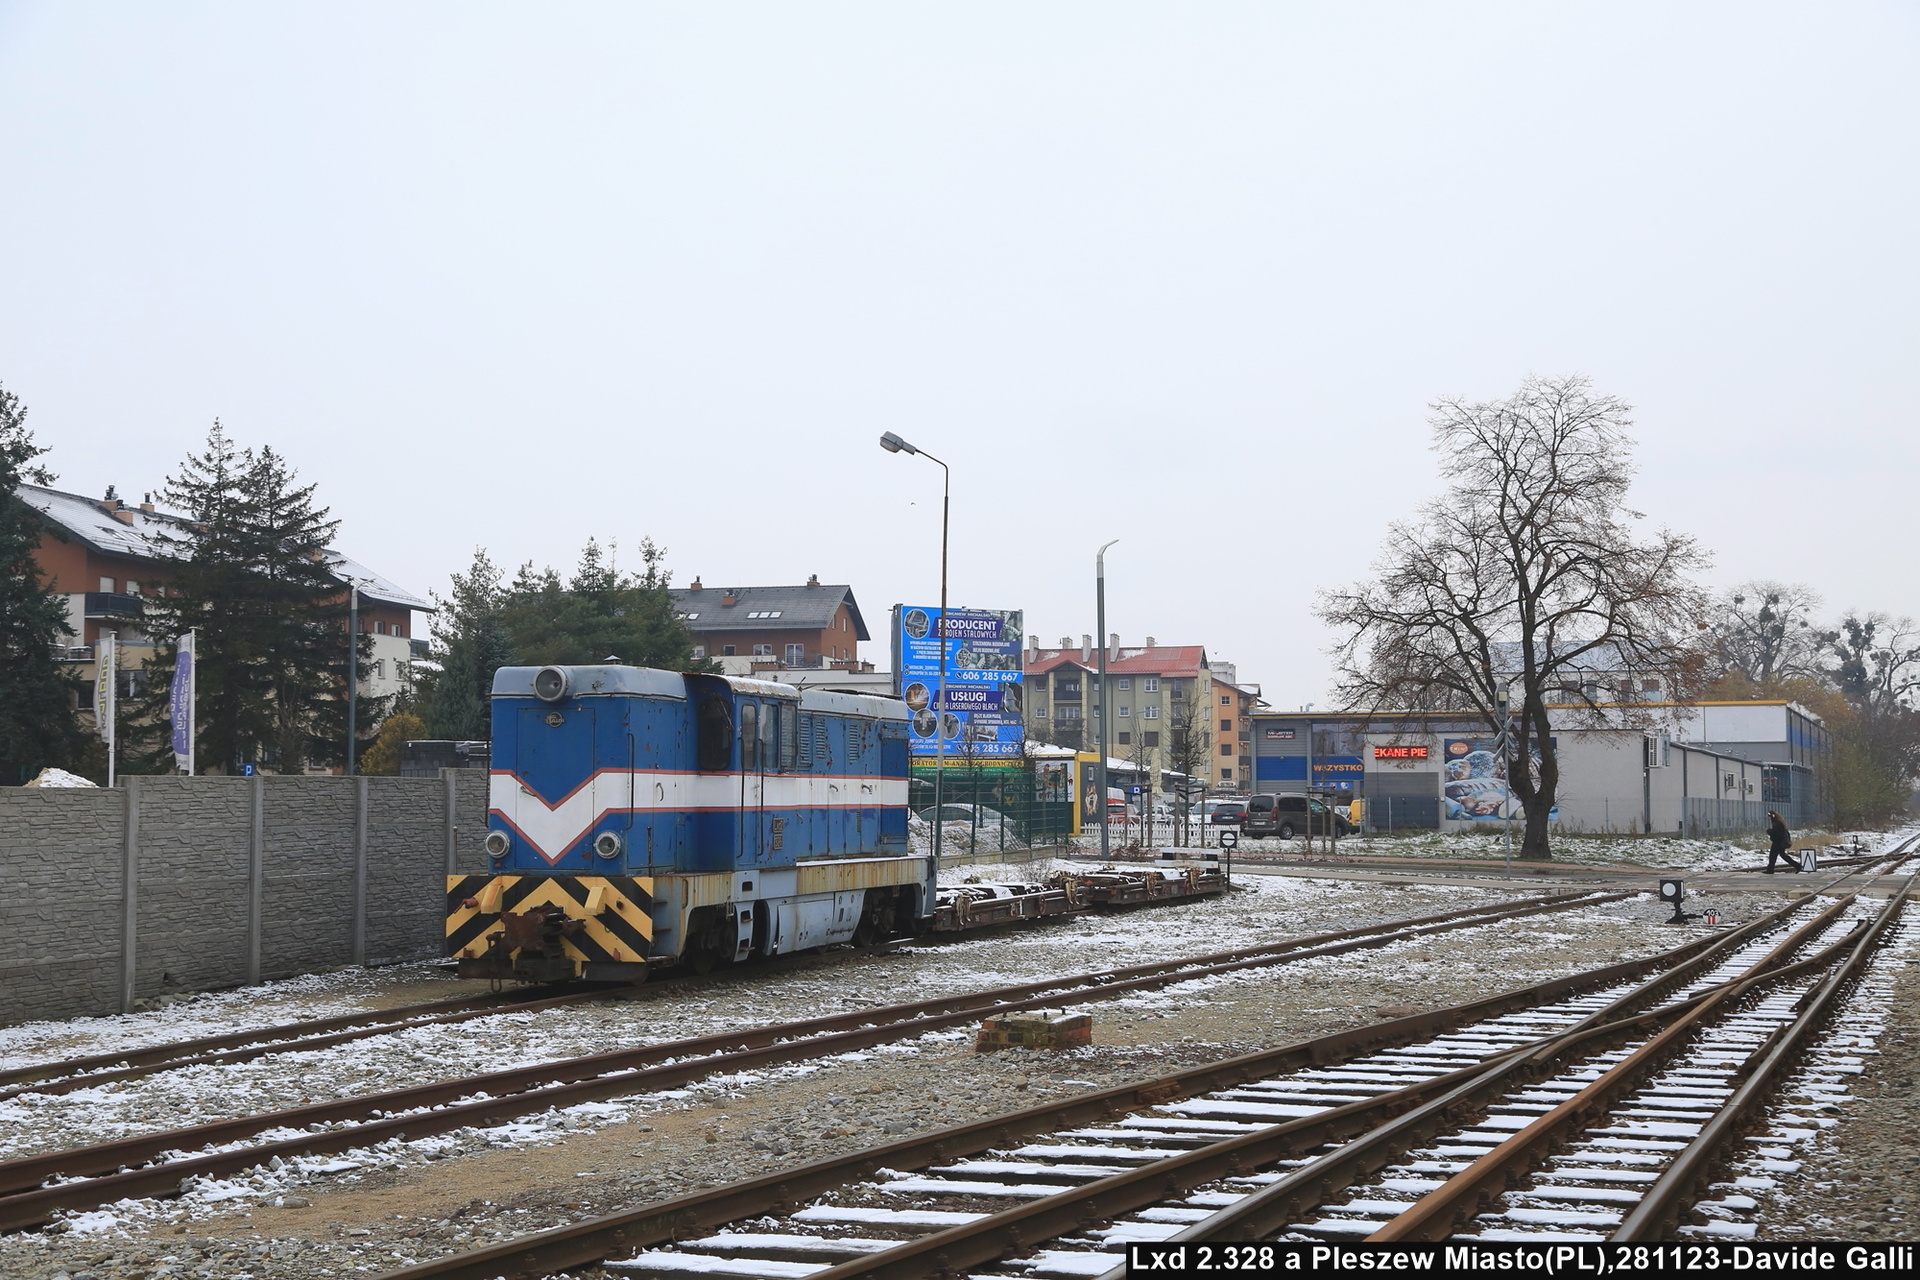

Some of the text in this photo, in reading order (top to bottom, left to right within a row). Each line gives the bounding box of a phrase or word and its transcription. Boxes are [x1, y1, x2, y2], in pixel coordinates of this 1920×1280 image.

[938, 618, 997, 630] PRODUCENT
[963, 630, 997, 638] STALOWYCH
[962, 671, 1018, 681] 606 285 667
[950, 691, 987, 702] USŁUGI
[949, 702, 982, 710] LASEROWEGO
[982, 703, 998, 711] BLACH
[983, 744, 999, 753] 285
[1001, 744, 1018, 753] 667
[1410, 747, 1427, 757] PIE
[245, 765, 252, 776] P
